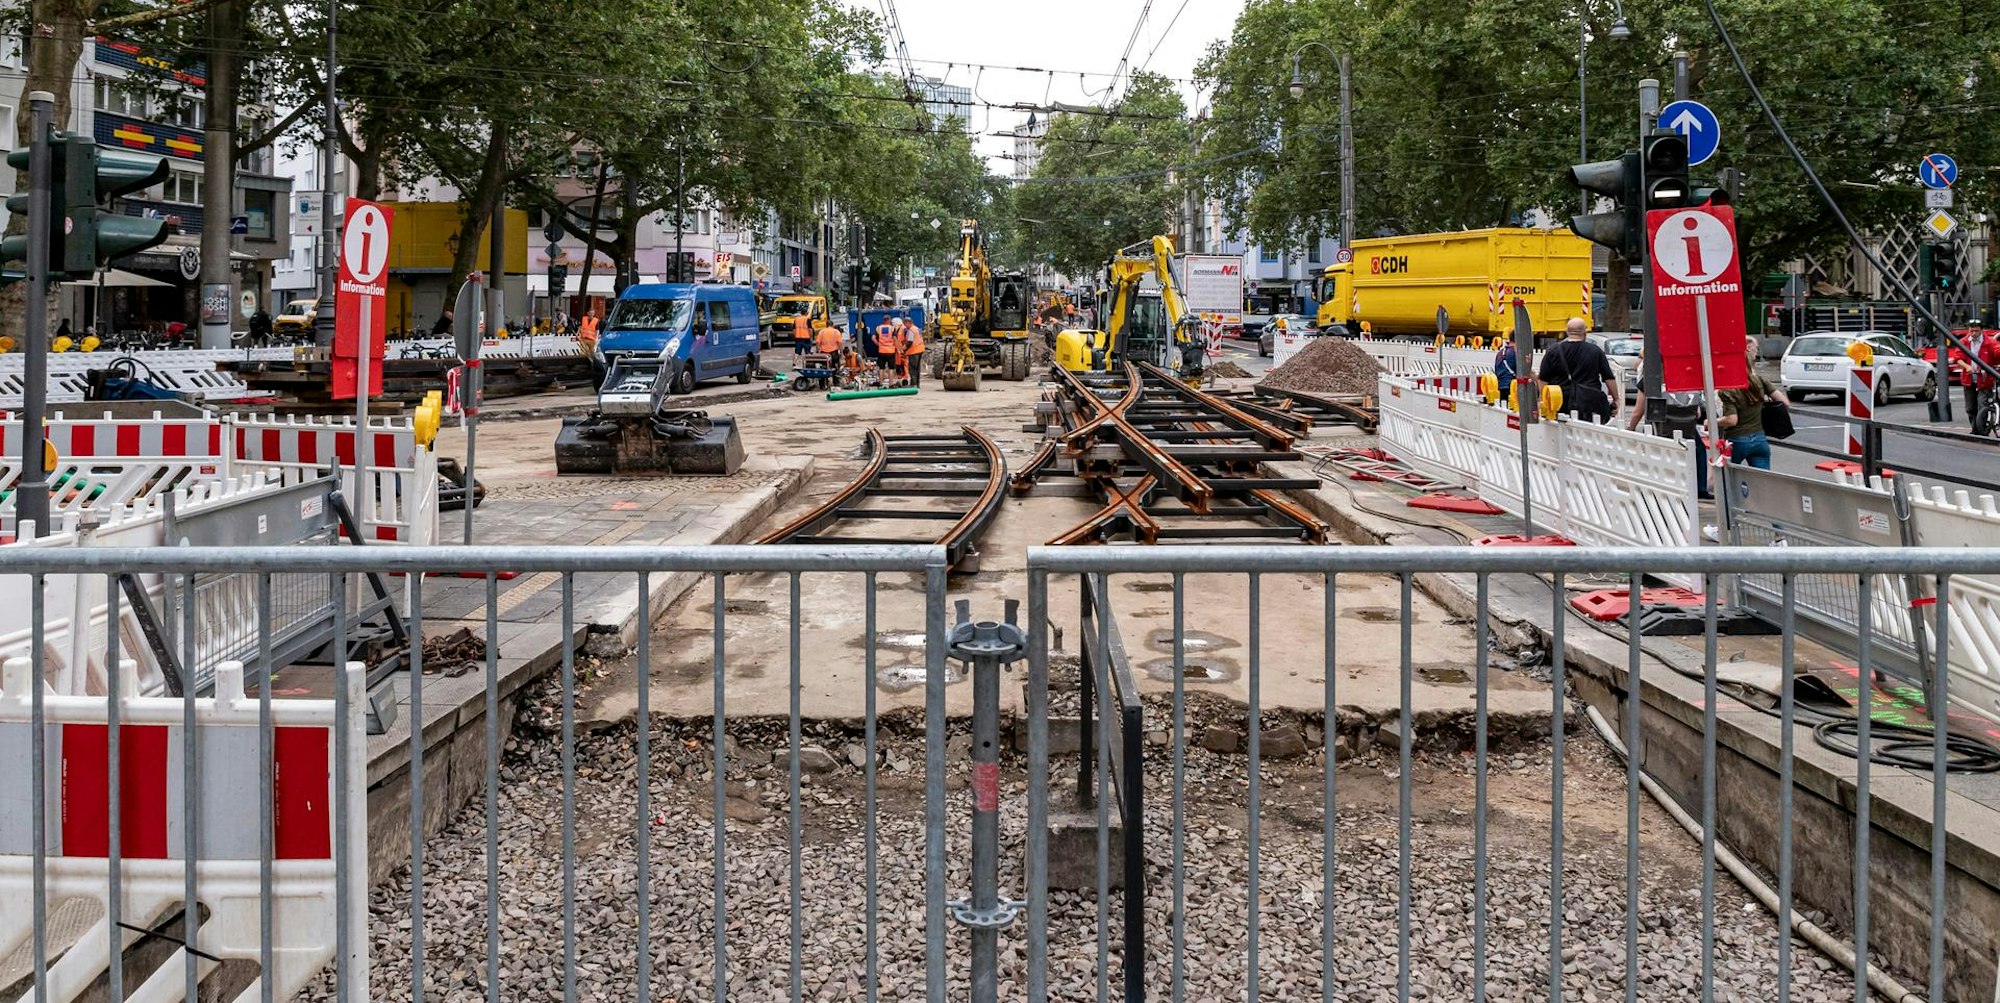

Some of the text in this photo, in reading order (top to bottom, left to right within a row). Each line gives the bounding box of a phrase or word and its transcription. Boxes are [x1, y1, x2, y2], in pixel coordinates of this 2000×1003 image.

[716, 253, 732, 262] EIS
[1340, 252, 1350, 261] 30
[1381, 255, 1408, 274] CDH
[340, 279, 386, 296] Information
[1513, 286, 1536, 295] CDH
[1658, 281, 1739, 297] Information
